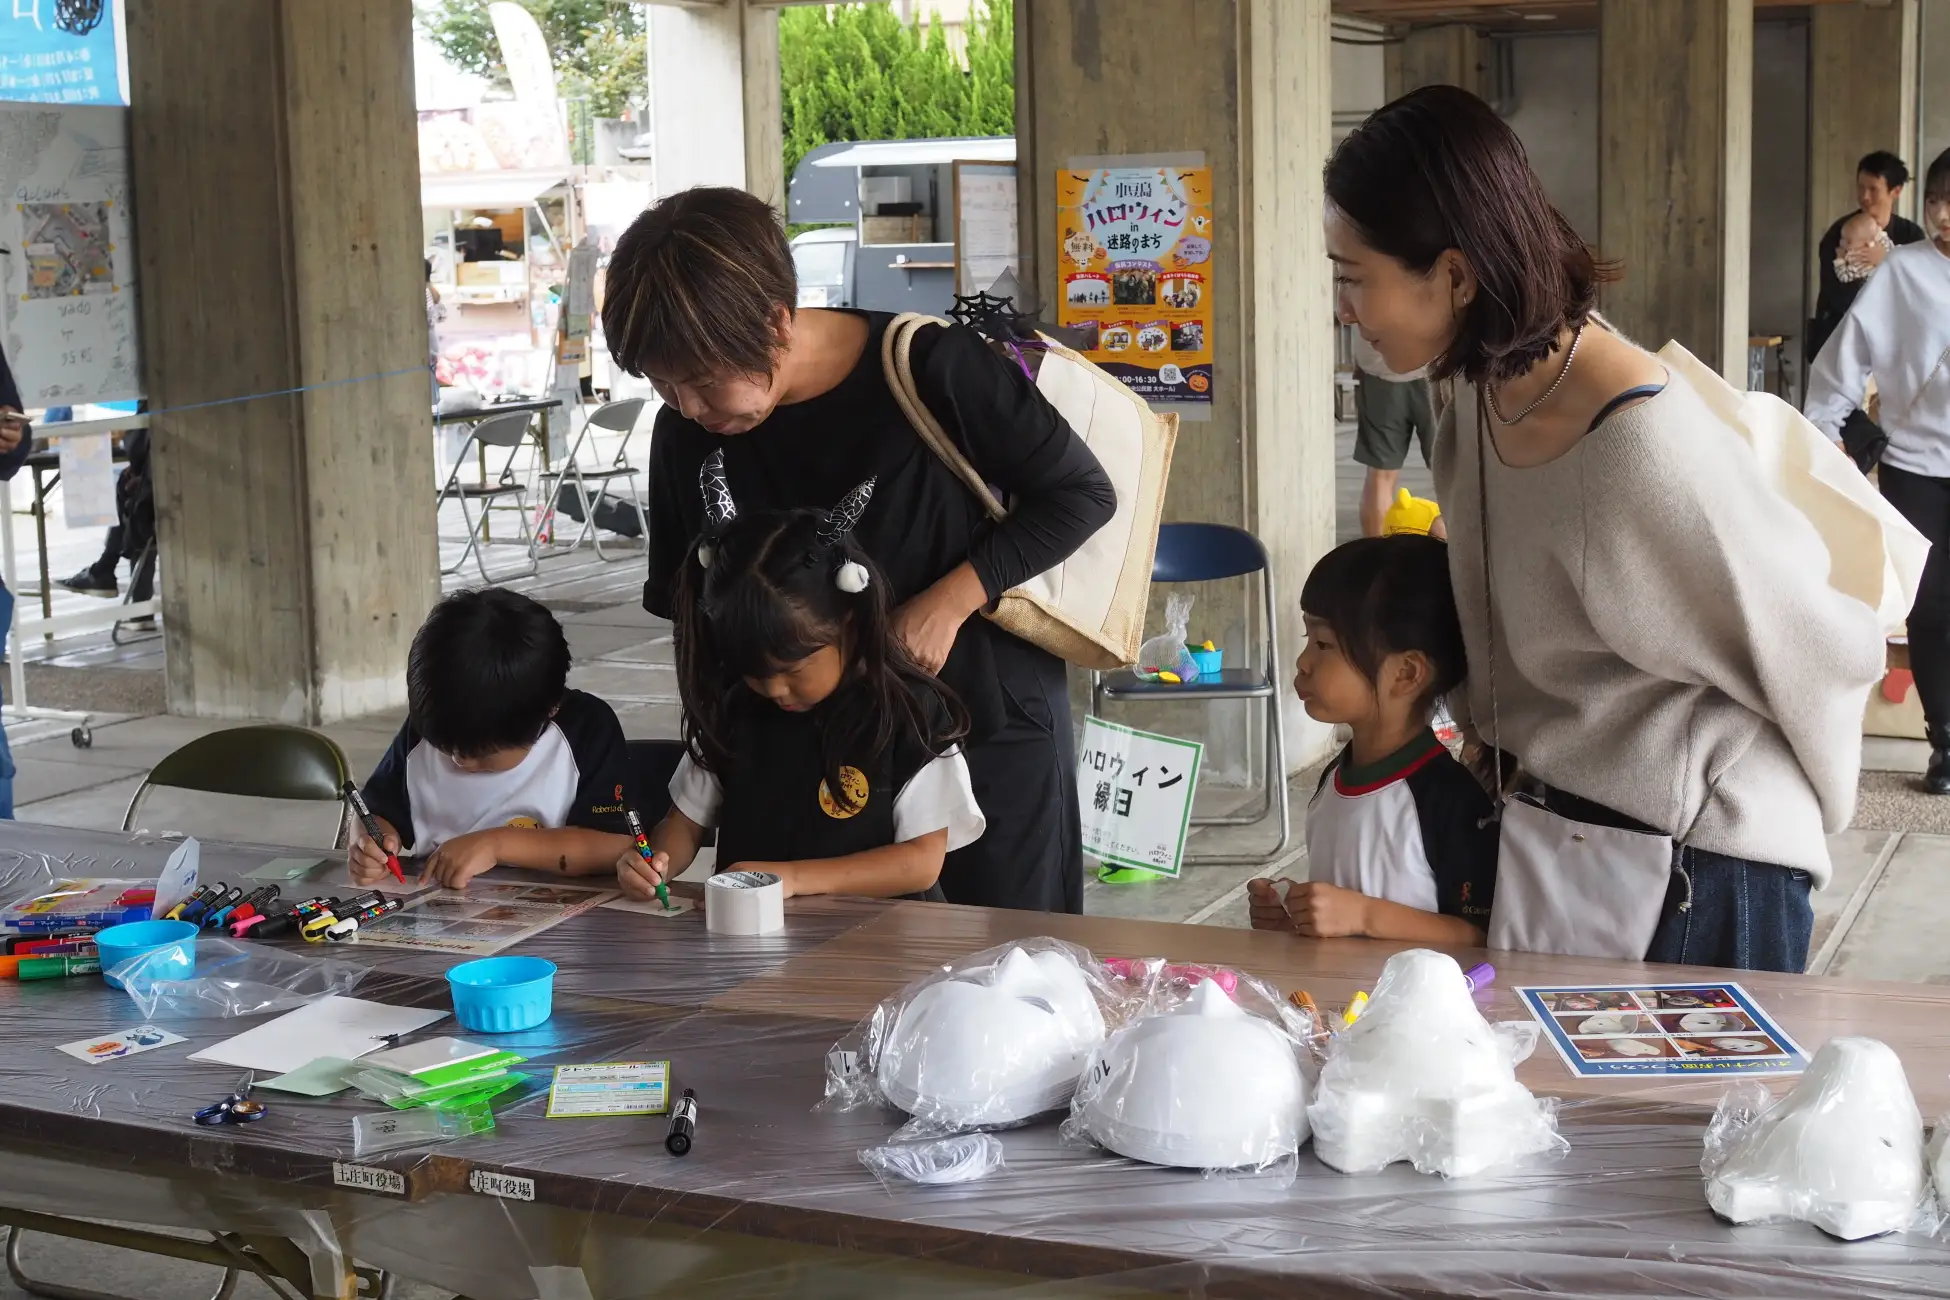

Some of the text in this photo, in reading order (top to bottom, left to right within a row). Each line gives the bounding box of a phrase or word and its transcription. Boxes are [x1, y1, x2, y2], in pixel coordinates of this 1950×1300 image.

[1115, 182, 1152, 198] 小豆島
[1086, 201, 1184, 231] ハロウィン
[1130, 221, 1139, 232] in
[1107, 233, 1163, 254] 迷路のまち
[1082, 748, 1183, 789] ハロウィン
[592, 805, 617, 814] Roberta
[1093, 780, 1133, 818] 縁日
[1093, 1059, 1111, 1084] 10
[336, 1164, 401, 1190] 土庄町役場
